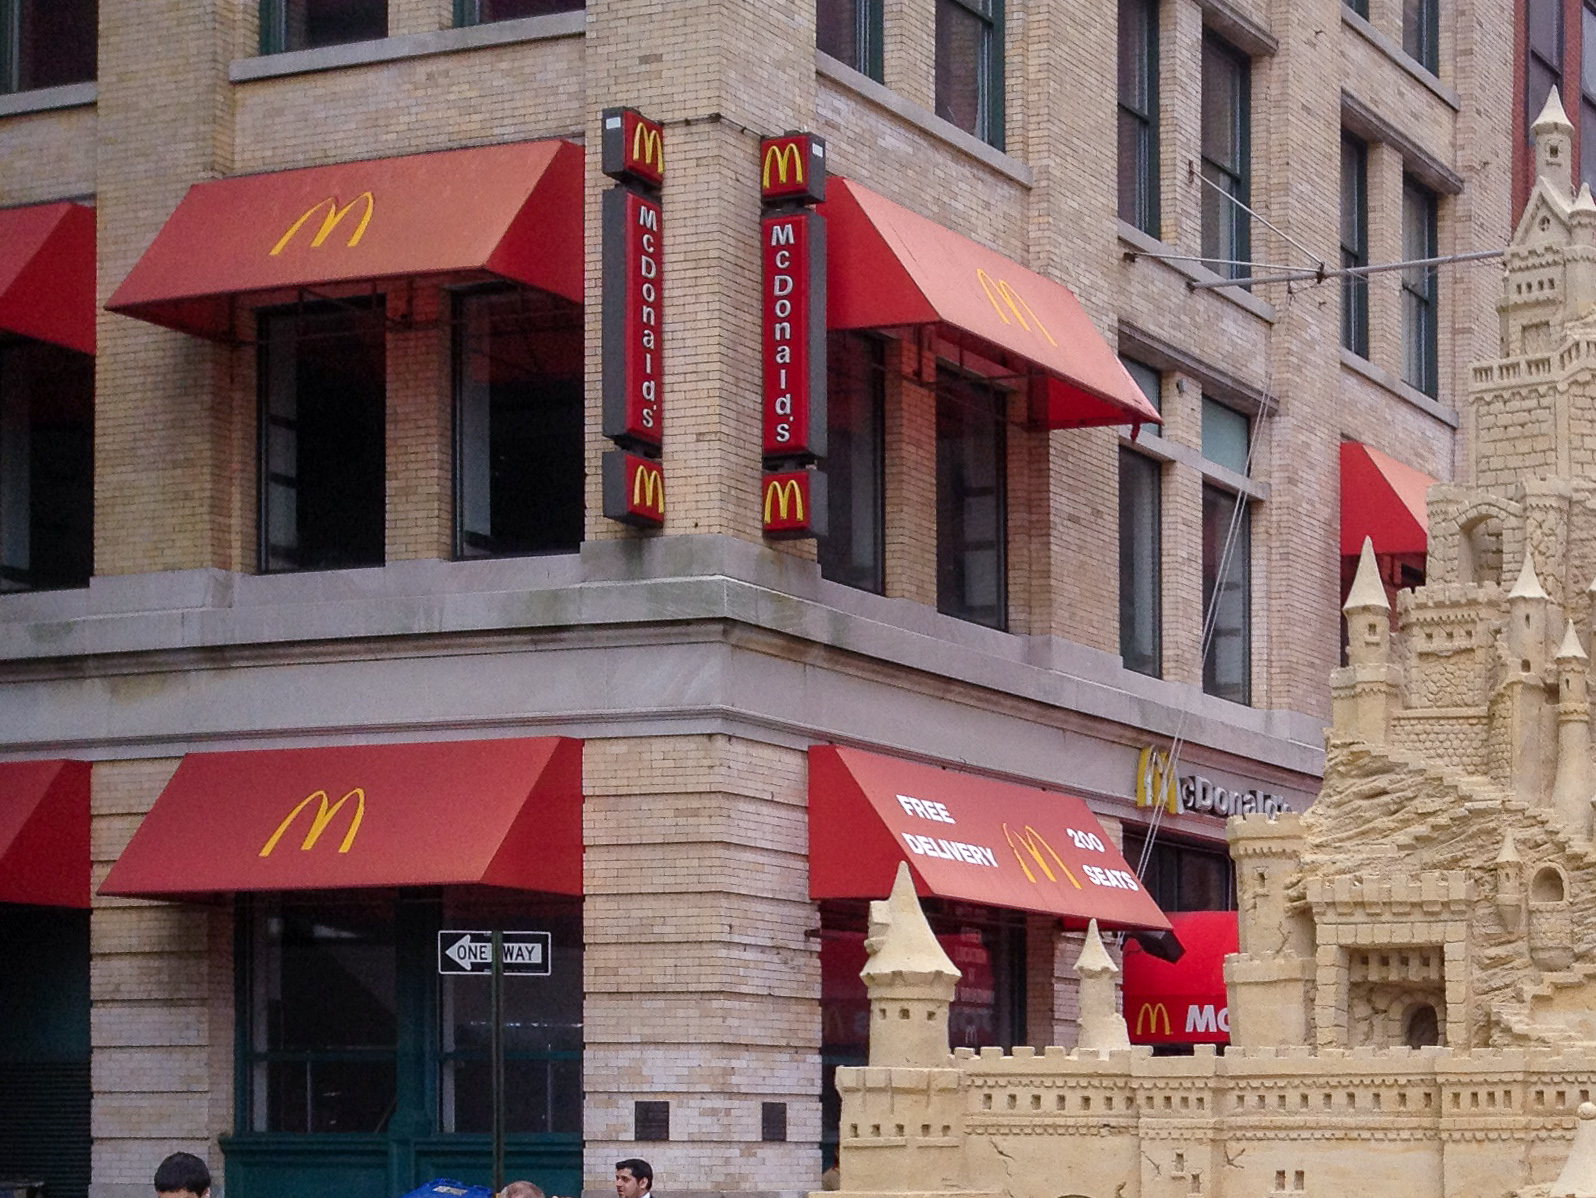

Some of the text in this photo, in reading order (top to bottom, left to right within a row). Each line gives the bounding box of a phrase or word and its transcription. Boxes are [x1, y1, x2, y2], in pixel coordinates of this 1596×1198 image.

[639, 205, 657, 428] McDonald's
[770, 223, 795, 442] McDonald's
[895, 794, 956, 824] FREE
[901, 832, 999, 868] DELIVERY
[1066, 828, 1105, 853] 200
[1082, 864, 1139, 892] SEATS
[456, 944, 536, 961] ONE WAY
